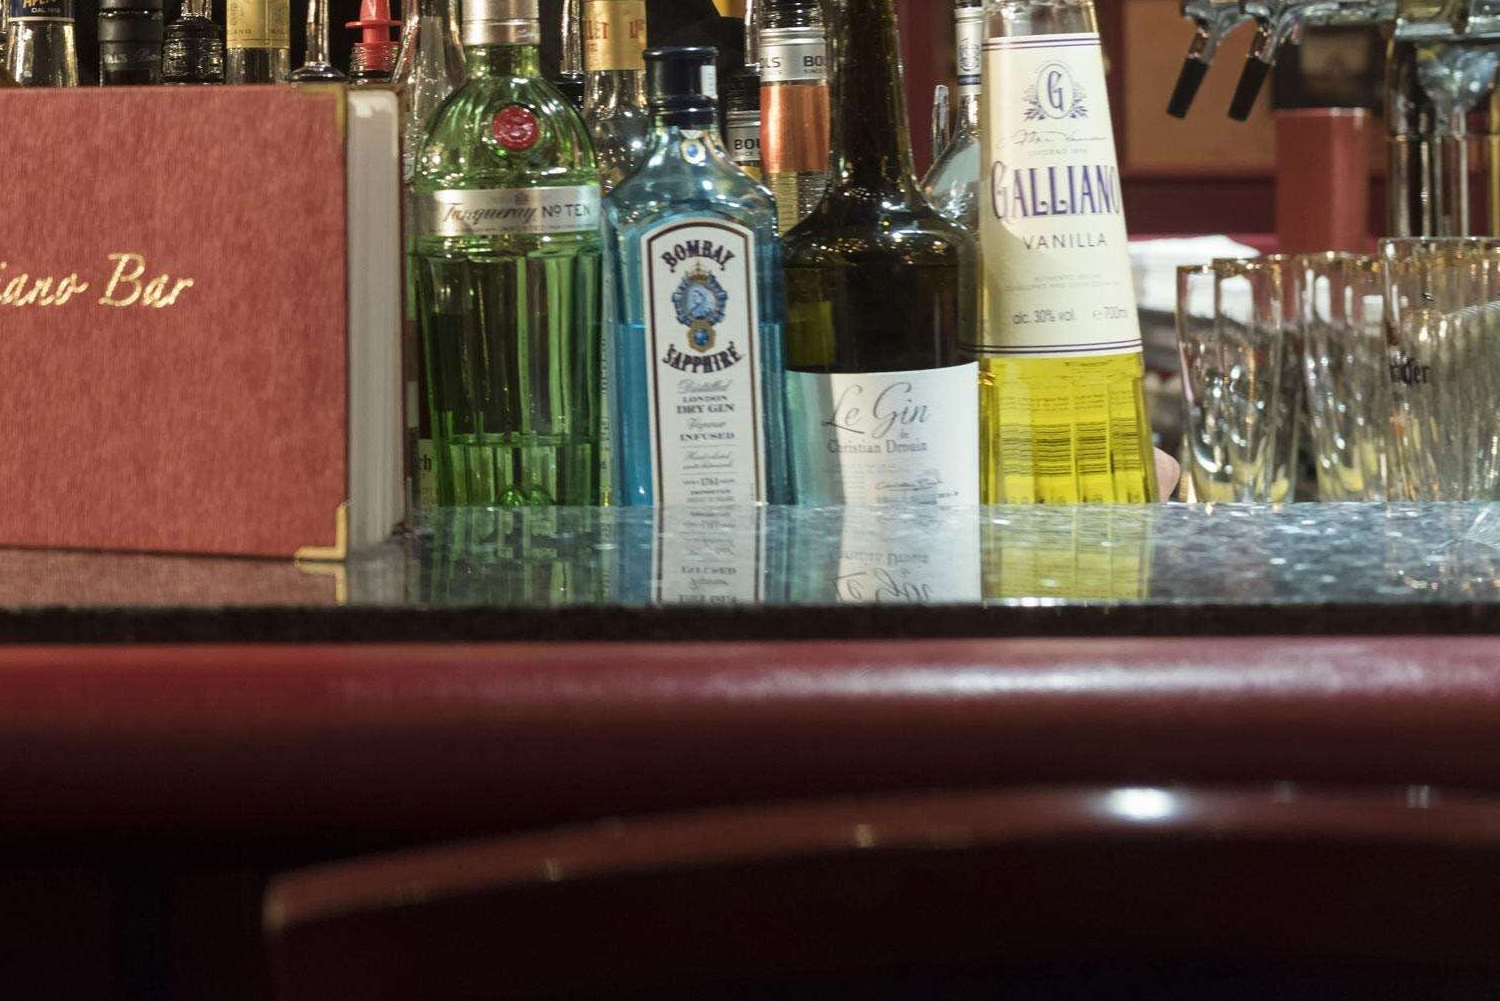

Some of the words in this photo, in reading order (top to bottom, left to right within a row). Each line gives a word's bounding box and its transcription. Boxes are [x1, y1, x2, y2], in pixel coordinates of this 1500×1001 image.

[443, 202, 538, 224] Tanqueray
[566, 202, 592, 218] TEN
[1022, 232, 1109, 250] VANILLA
[660, 239, 735, 273] BOMBAY
[98, 252, 195, 308] Bar
[662, 341, 742, 374] SAPPHIRE
[676, 404, 705, 414] DRY
[707, 403, 736, 413] GIN
[820, 384, 866, 435] Le
[871, 381, 931, 439] Gin
[827, 439, 882, 455] Christian
